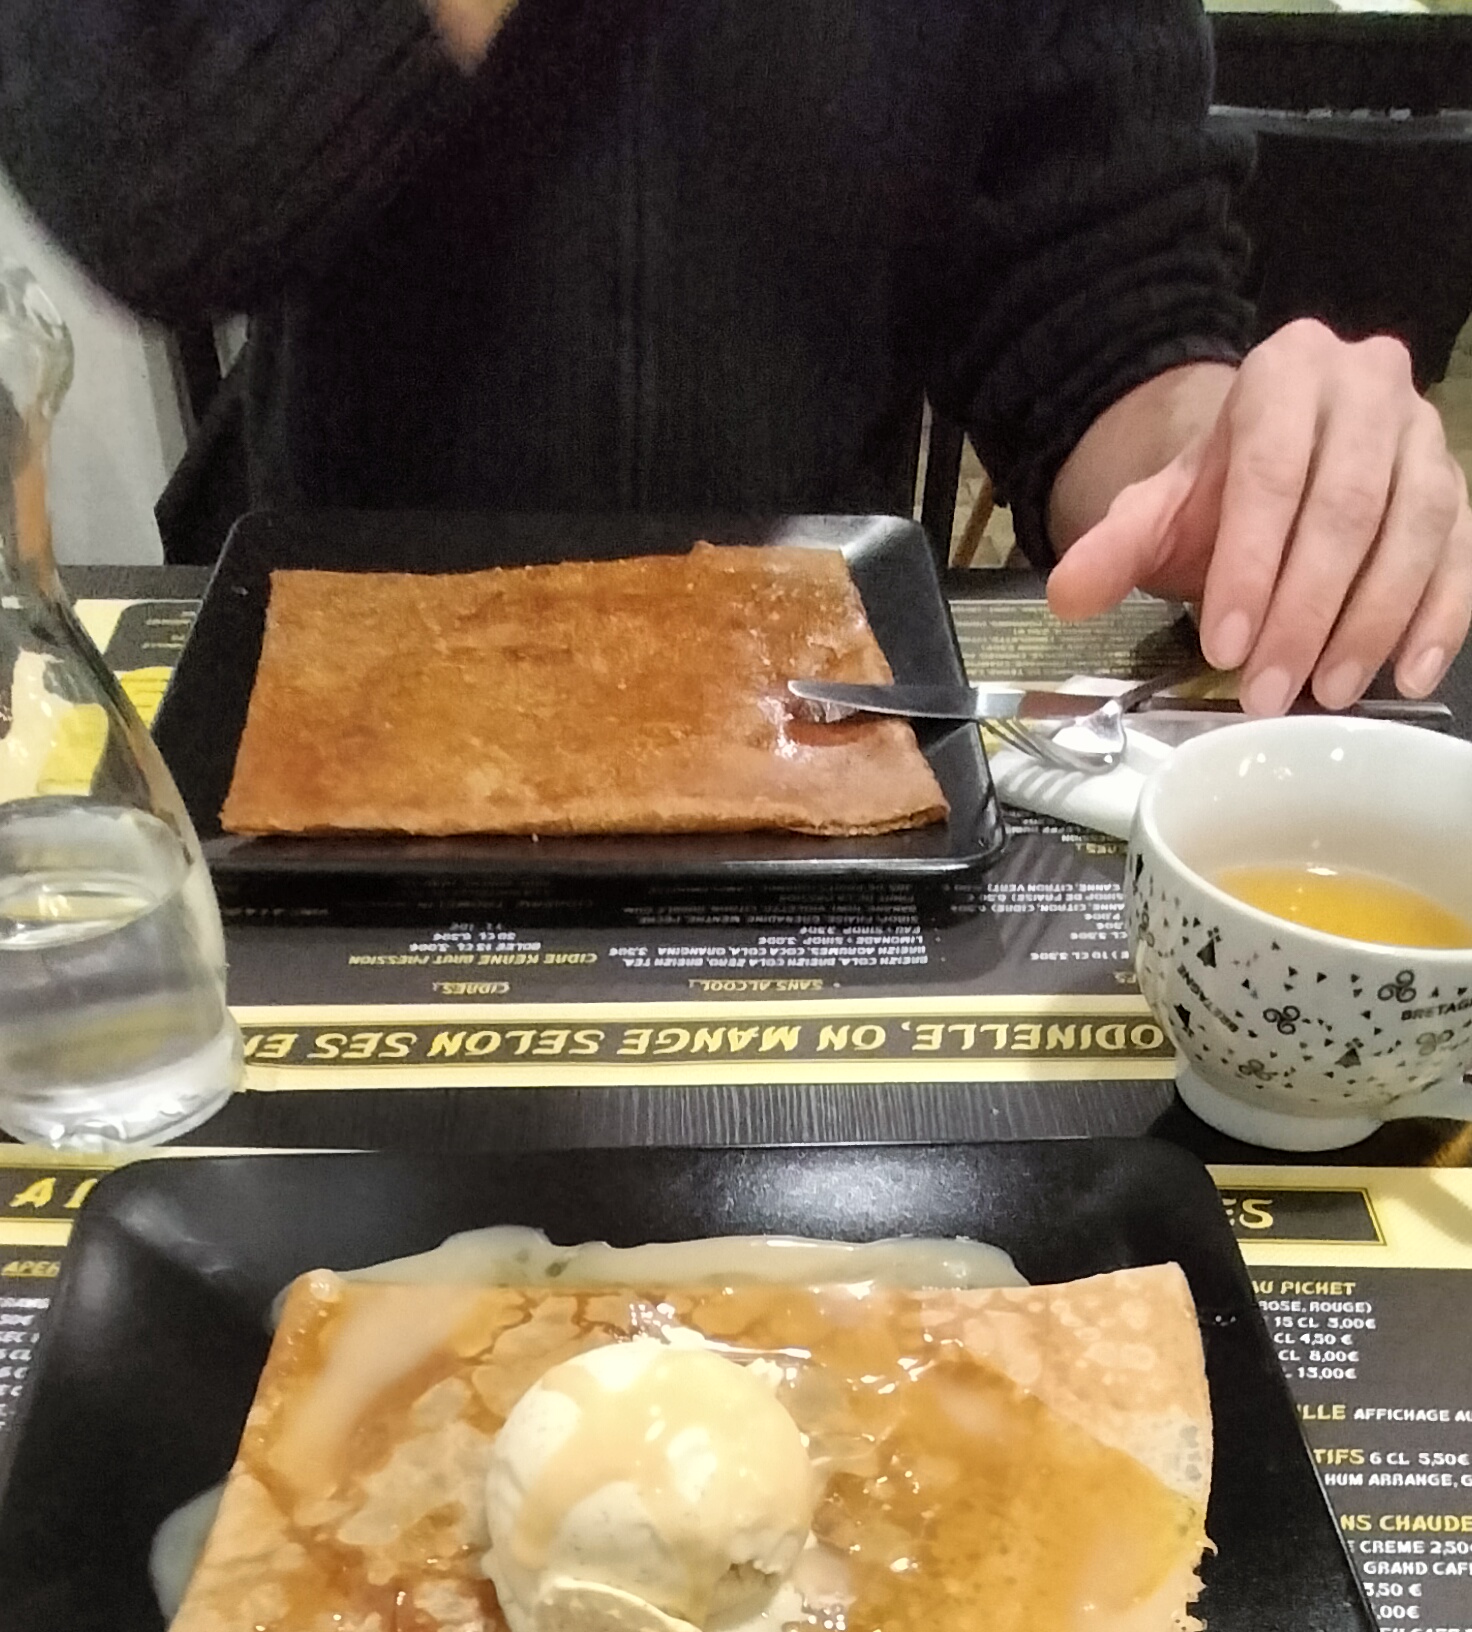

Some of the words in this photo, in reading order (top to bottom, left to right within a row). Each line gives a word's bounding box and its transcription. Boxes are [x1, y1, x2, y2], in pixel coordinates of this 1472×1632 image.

[856, 936, 923, 945] LIMONADE
[543, 952, 598, 964] CIDRE
[658, 947, 726, 956] ORANGINA
[770, 947, 805, 956] COCA
[1071, 951, 1089, 960] CL
[348, 954, 430, 965] PRESSION
[432, 954, 474, 964] BRUT
[749, 957, 785, 967] COLA
[442, 982, 510, 994] CIDRES
[701, 979, 771, 991] ALCOOL
[776, 979, 823, 991] SANS
[1401, 998, 1472, 1021] BRETAG
[426, 1029, 606, 1057] SELON
[616, 1027, 802, 1055] MANGE
[816, 1024, 886, 1052] ON
[901, 1021, 1164, 1051] ODINELLE,
[306, 1032, 418, 1059] SES
[9, 1177, 57, 1208] A
[1280, 1280, 1356, 1296] PICHET
[1309, 1301, 1372, 1314] ROUGE)
[1274, 1316, 1294, 1328] 15
[1297, 1316, 1319, 1329] CL
[1273, 1332, 1296, 1344] CL
[1278, 1349, 1301, 1361] CL
[1297, 1403, 1346, 1420] LLE
[1353, 1408, 1450, 1422] AFFICHAGE
[1313, 1448, 1365, 1465] TIFS
[1369, 1452, 1382, 1465] 6
[1386, 1452, 1410, 1465] CL
[1324, 1473, 1364, 1486] HUM
[1368, 1473, 1459, 1488] ARRANGE,
[1340, 1514, 1372, 1532] NS
[1360, 1540, 1425, 1554] CREME
[1429, 1540, 1472, 1555] 2,50
[1363, 1561, 1428, 1575] GRAND
[1432, 1561, 1472, 1576] CAF
[1373, 1604, 1420, 1620] ,00€
